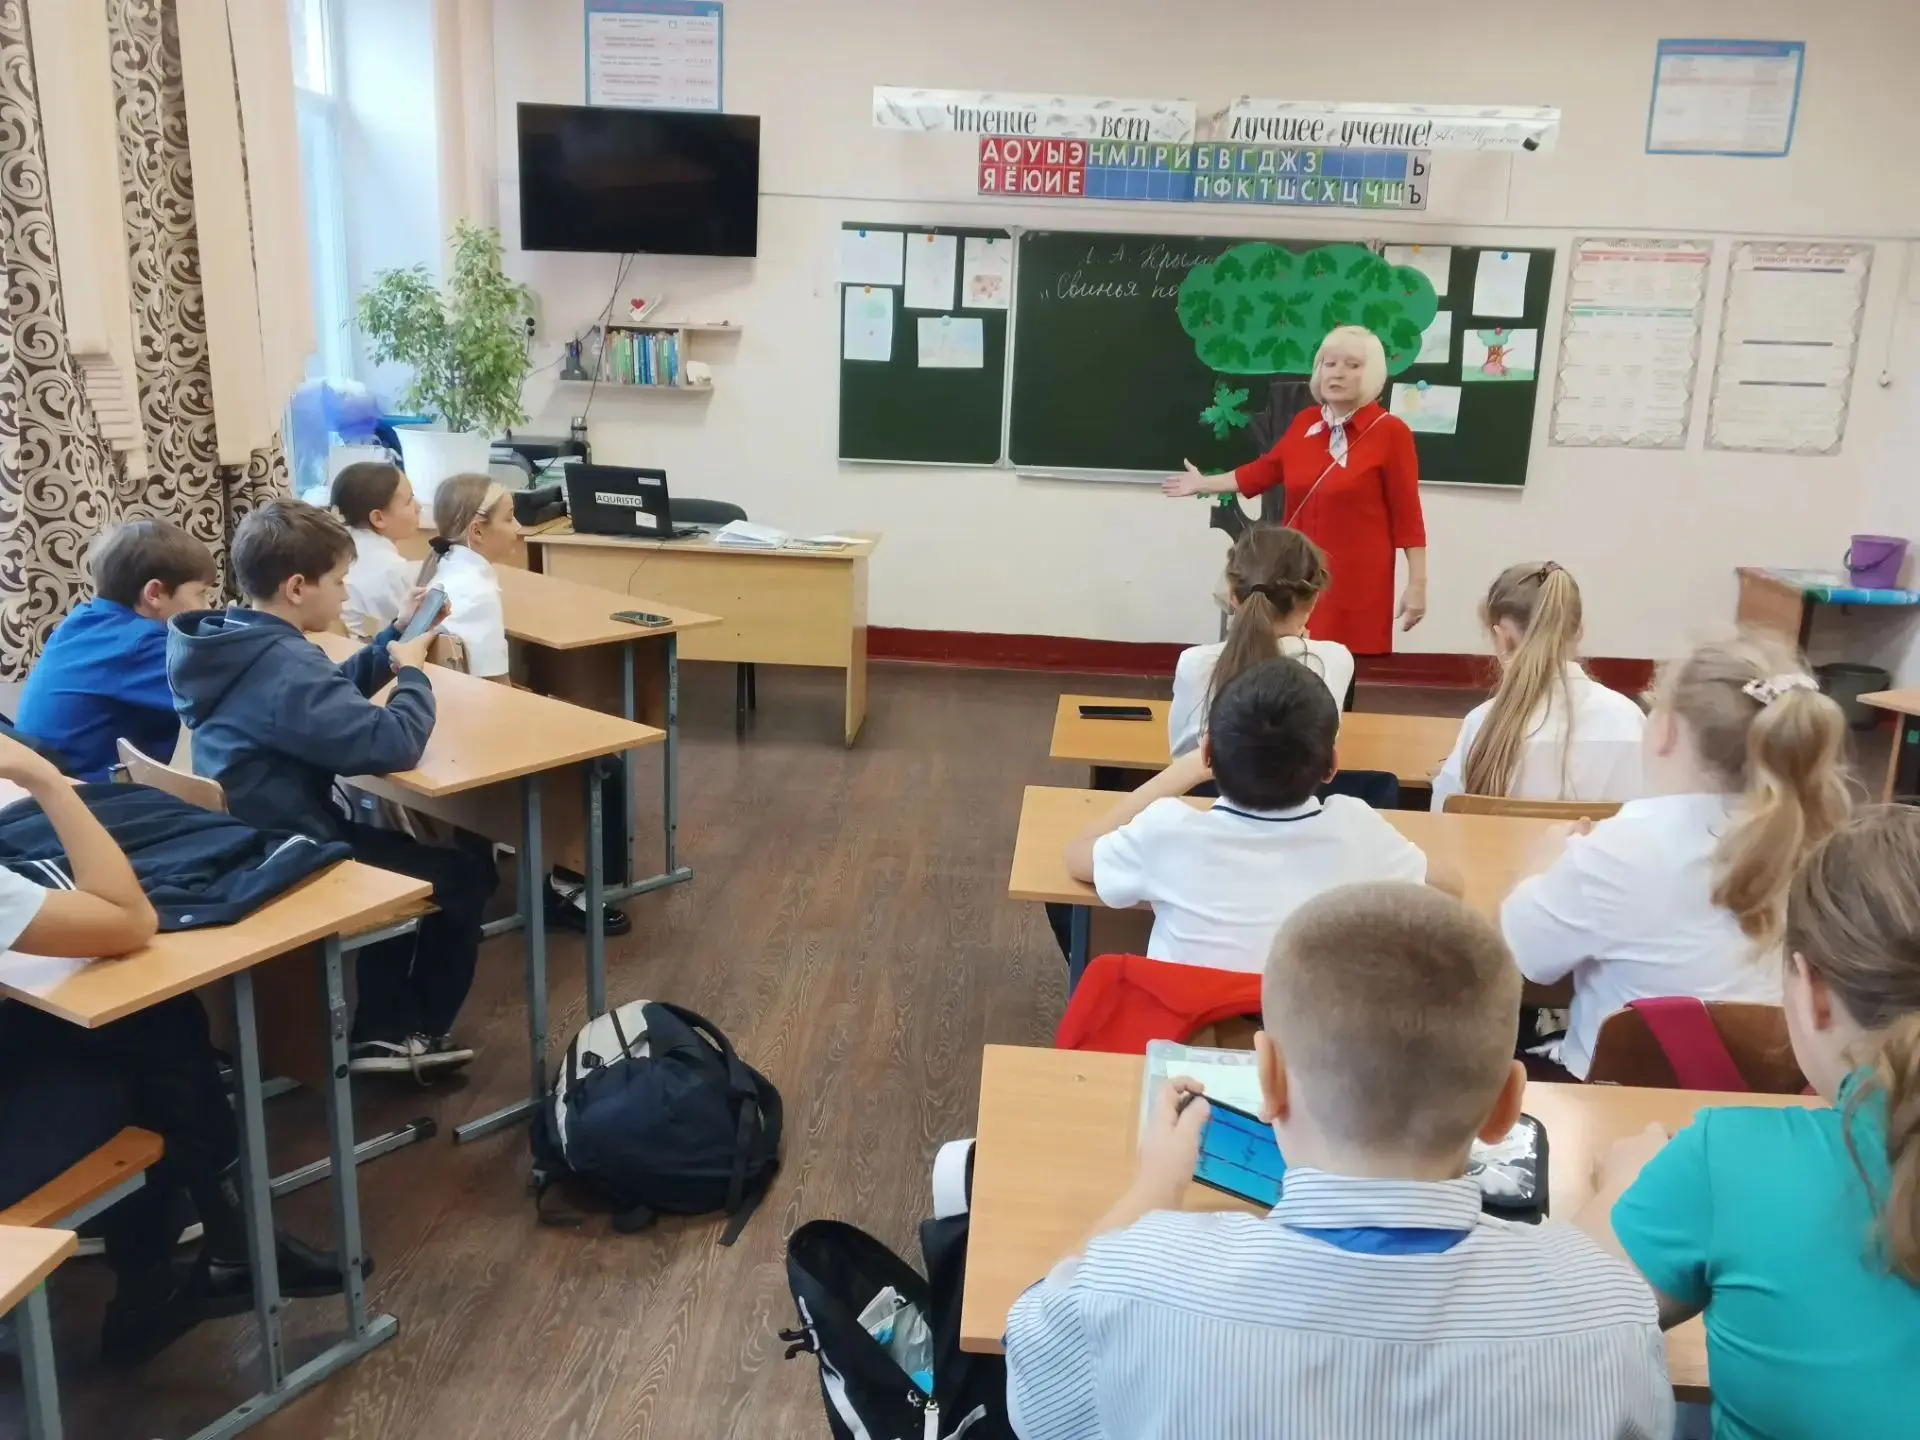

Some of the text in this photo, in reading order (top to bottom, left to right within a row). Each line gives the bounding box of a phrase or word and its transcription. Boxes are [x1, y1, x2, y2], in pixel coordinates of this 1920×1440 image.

[946, 103, 1151, 143] Чтение вот
[1339, 118, 1433, 148] учение!
[596, 494, 642, 506] AQURISTO
